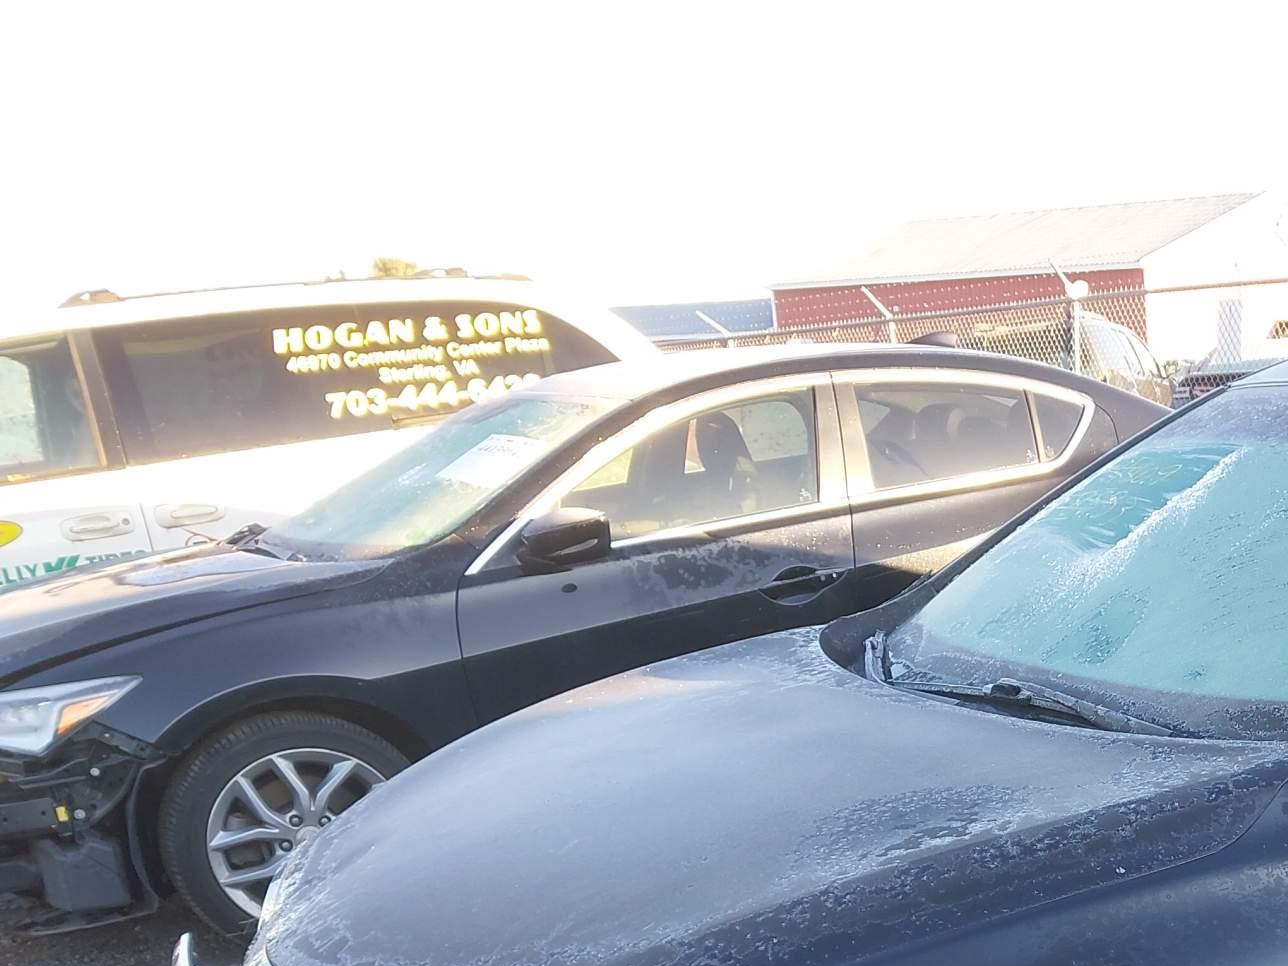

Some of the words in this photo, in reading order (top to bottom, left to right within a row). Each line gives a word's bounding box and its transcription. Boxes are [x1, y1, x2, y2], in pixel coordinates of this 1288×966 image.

[272, 318, 415, 354] HOGAN
[422, 316, 449, 341] &
[454, 309, 542, 338] SONS
[343, 345, 444, 369] Community
[446, 340, 502, 360] Center
[504, 336, 551, 353] Plaza
[453, 358, 481, 377] VA
